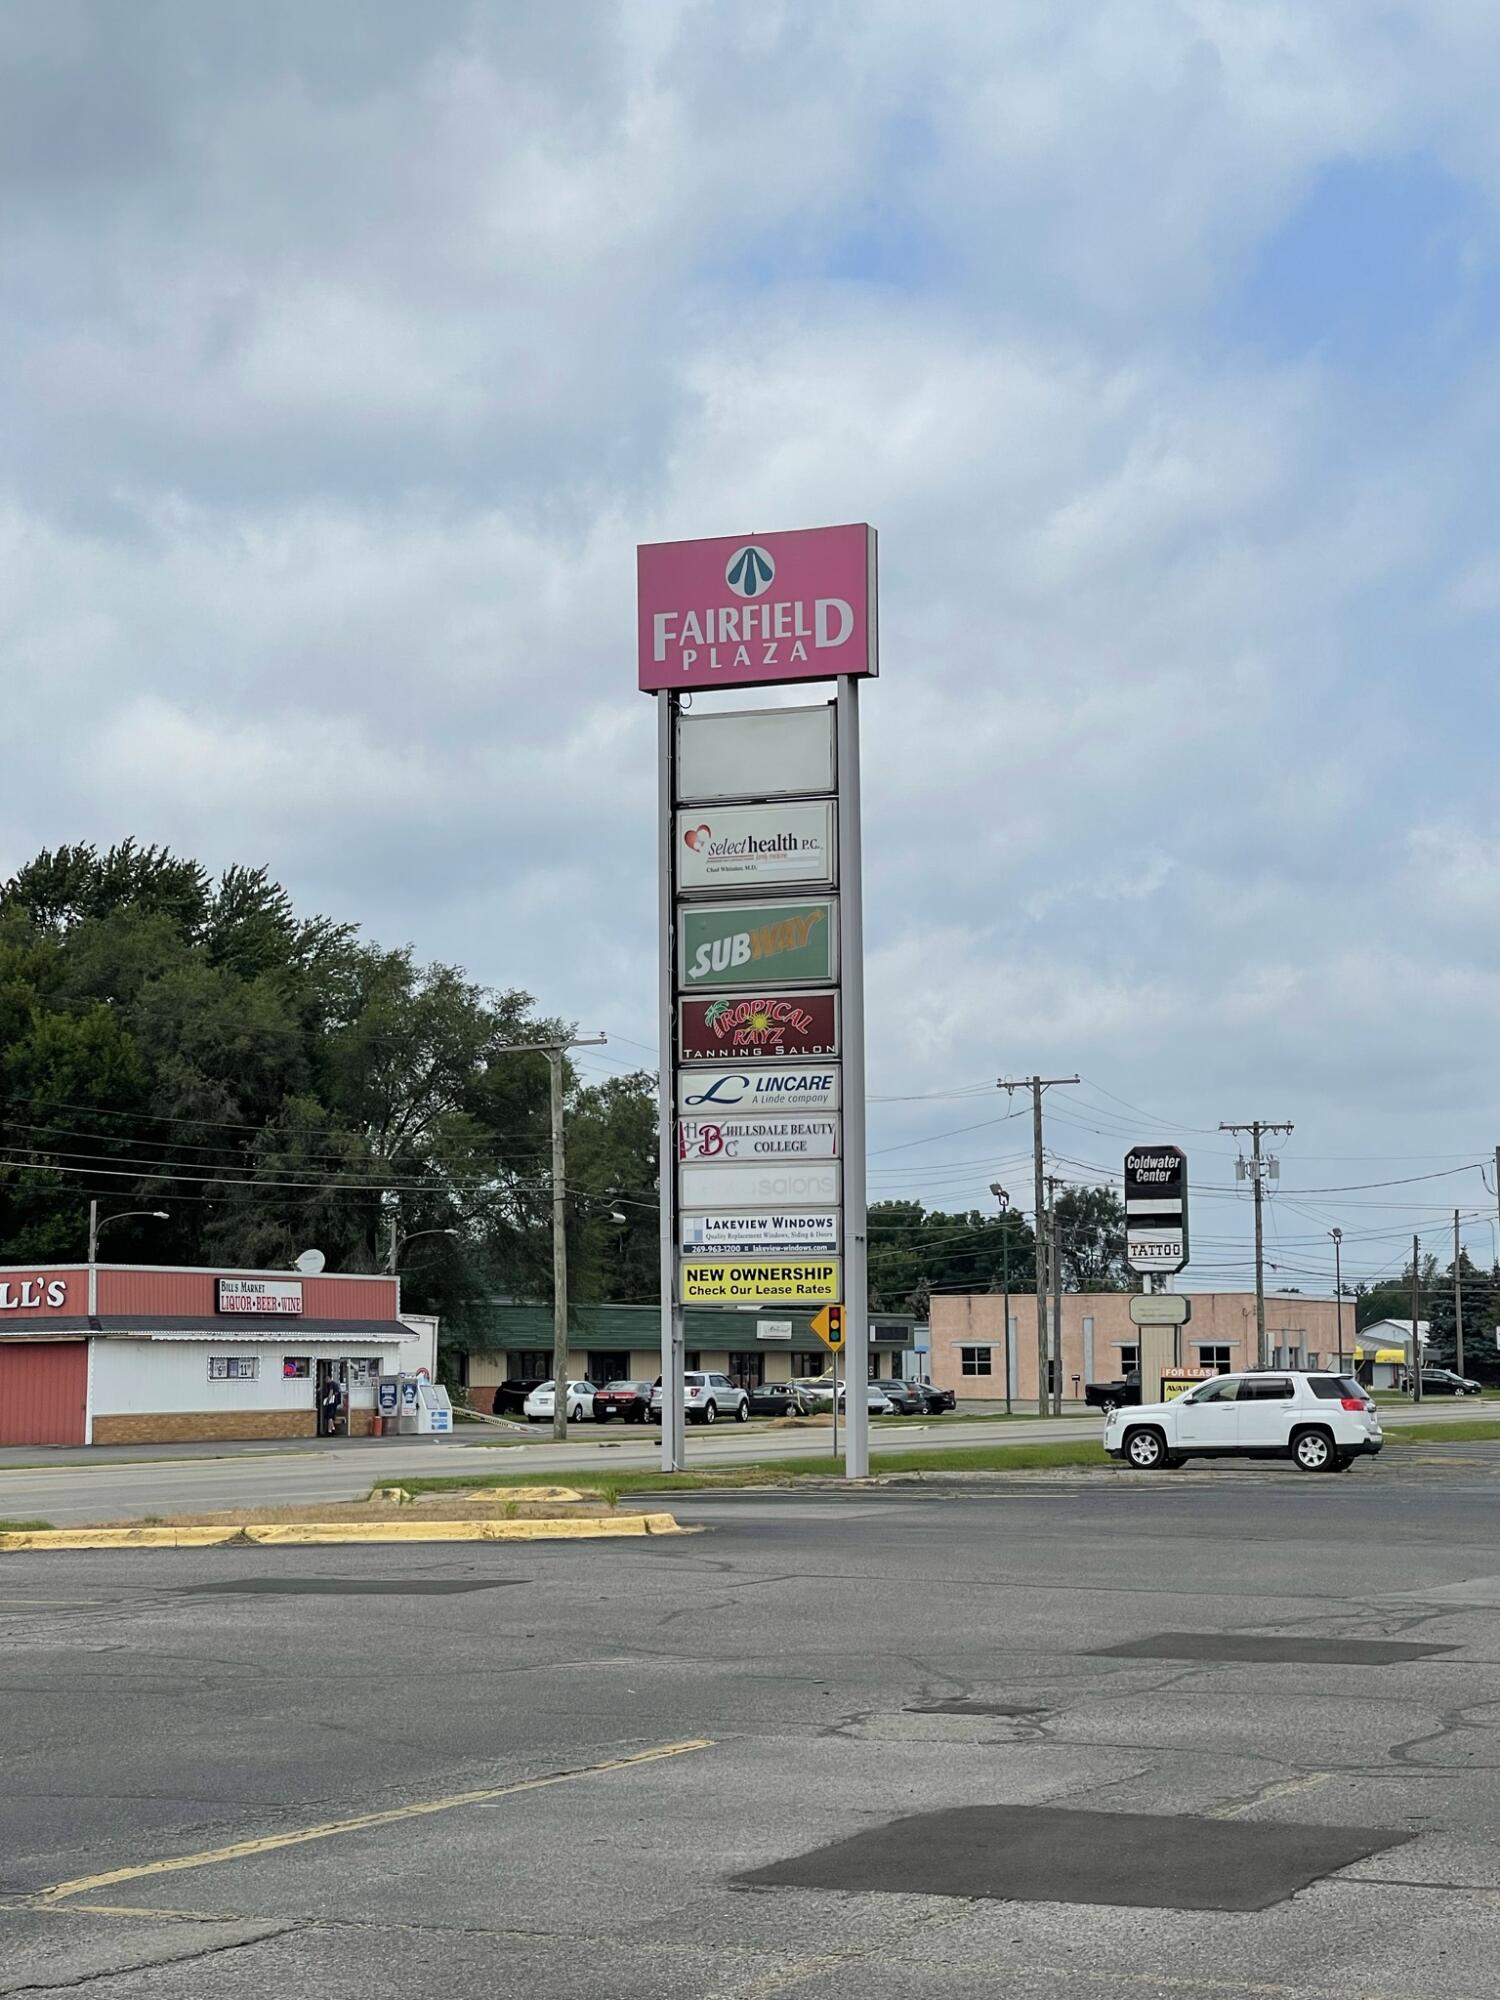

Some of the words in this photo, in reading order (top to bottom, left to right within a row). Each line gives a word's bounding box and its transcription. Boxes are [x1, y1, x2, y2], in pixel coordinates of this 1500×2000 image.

[653, 598, 854, 662] FAIRFIELD
[682, 641, 808, 670] PLAZA
[688, 910, 824, 979] SUBWAY
[733, 1027, 786, 1045] RAYZ
[683, 1047, 763, 1058] TANNING
[775, 1045, 835, 1055] SALON
[755, 1075, 834, 1092] LINCARE
[752, 1096, 758, 1104] A
[761, 1094, 785, 1103] Linde
[788, 1094, 828, 1105] company
[726, 1123, 789, 1137] HILLSDALE
[791, 1123, 835, 1135] BEAUTY
[754, 1140, 807, 1153] COLLEGE
[1127, 1155, 1181, 1169] Coldwater
[1136, 1168, 1171, 1182] Center
[758, 1175, 833, 1195] salons
[705, 1218, 768, 1230] LAKEVIEW
[772, 1217, 833, 1228] WINDOWS
[705, 1233, 727, 1241] Quality
[728, 1232, 762, 1240] Replacement
[691, 1245, 741, 1253] 269-963-1200
[752, 1244, 828, 1252] lakeview-windows.com
[1130, 1244, 1180, 1256] TATTOO
[687, 1269, 725, 1282] NEW
[730, 1267, 833, 1281] OWNERSHIP
[240, 1282, 265, 1293] MARKET
[689, 1285, 726, 1295] Check
[730, 1285, 752, 1295] Our
[755, 1284, 792, 1294] Lease
[796, 1284, 832, 1294] Rates
[221, 1295, 252, 1311] LIQUOR
[256, 1296, 277, 1311] BEER
[281, 1297, 301, 1311] WINE
[1165, 1368, 1184, 1377] FOR
[1187, 1367, 1218, 1377] LEASE
